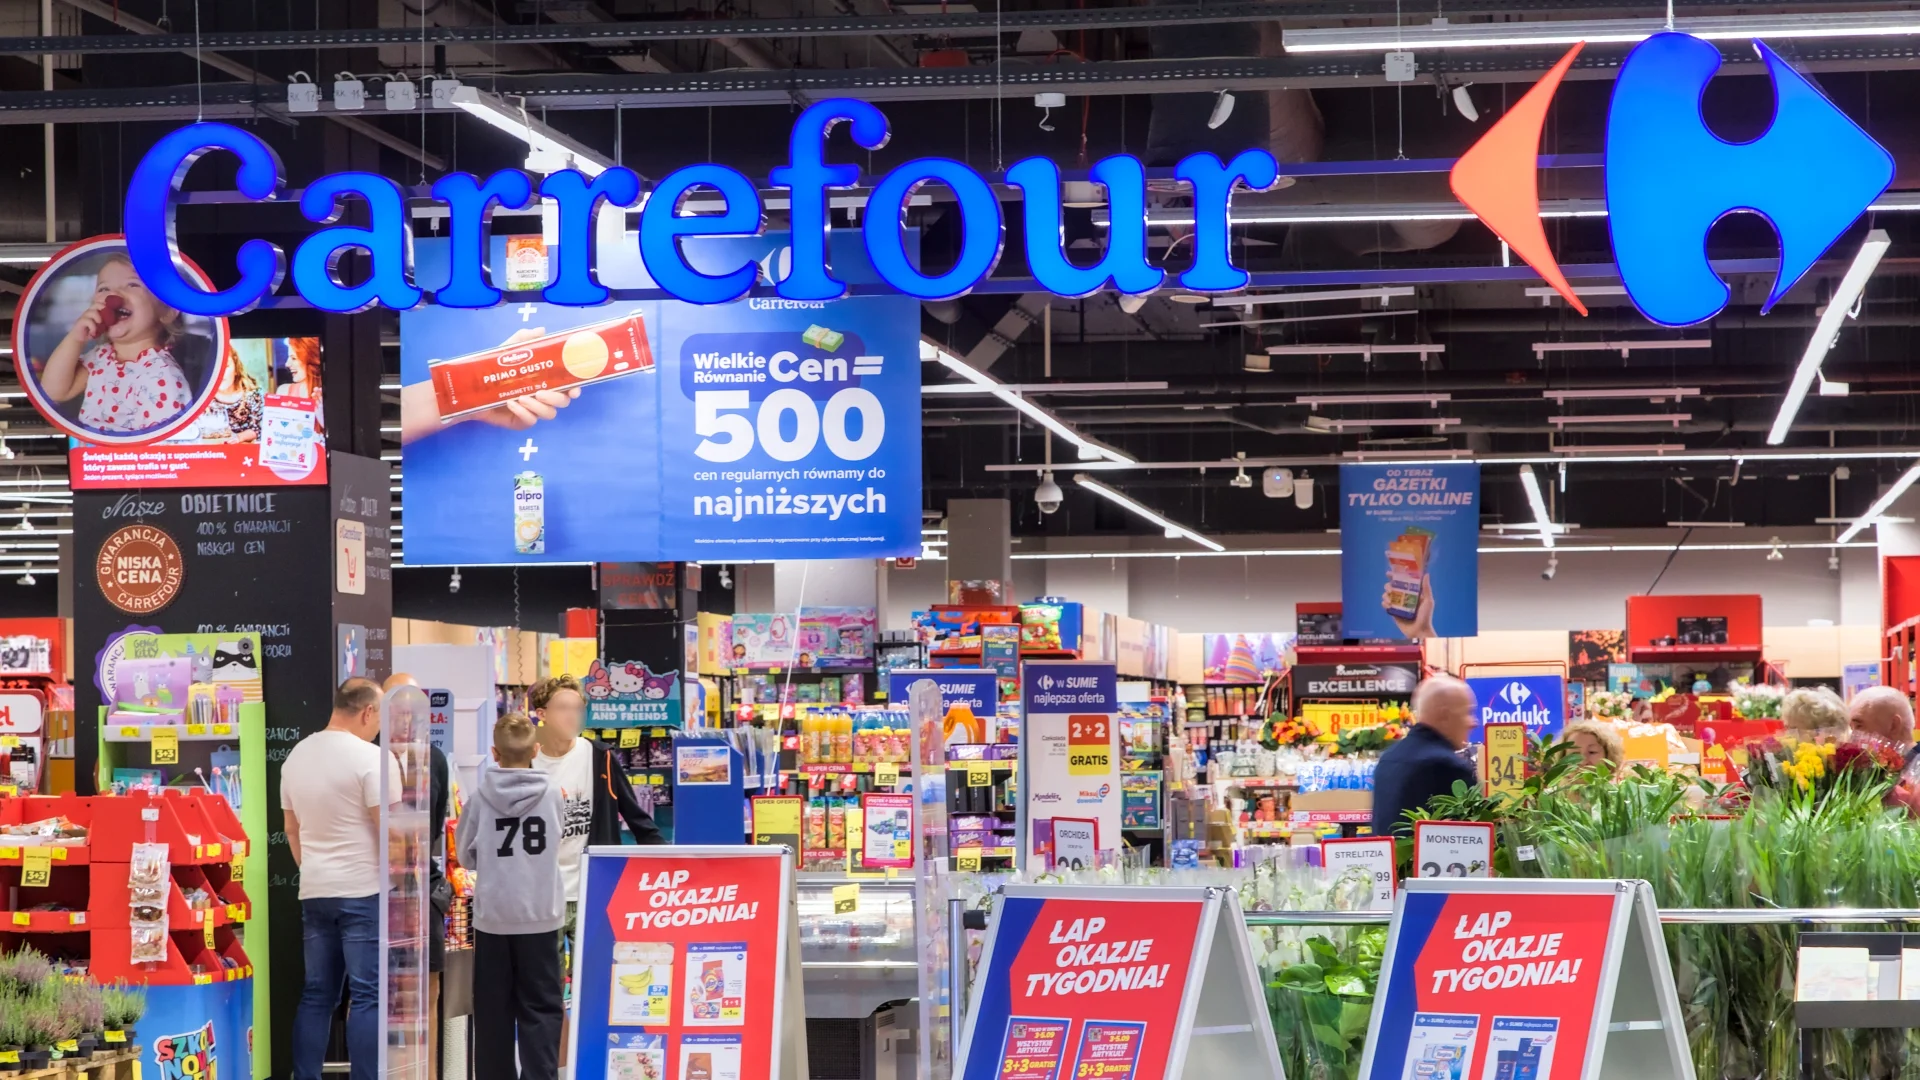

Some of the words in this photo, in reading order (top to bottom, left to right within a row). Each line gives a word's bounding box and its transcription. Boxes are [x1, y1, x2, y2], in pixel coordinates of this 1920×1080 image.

[125, 98, 1278, 317] Carrefour
[693, 351, 767, 370] Wielkie
[483, 369, 517, 384] PRIMO
[520, 360, 554, 375] GUSTO
[693, 370, 767, 384] Równanie
[694, 387, 886, 463] 500
[82, 451, 113, 462] Świętuj
[114, 451, 138, 462] każdą
[139, 451, 167, 461] okazję
[83, 462, 106, 472] który
[107, 464, 136, 472] zawsze
[160, 463, 169, 471] w
[1386, 469, 1401, 477] OD
[1404, 469, 1434, 477] TERAZ
[693, 470, 718, 481] cen
[720, 468, 800, 483] regularnych
[803, 467, 866, 482] równamy
[868, 467, 886, 479] do
[1373, 478, 1448, 491] GAZETKI
[515, 489, 542, 502] alpro
[1348, 493, 1403, 506] TYLKO
[1407, 492, 1473, 505] ONLINE
[101, 493, 167, 519] Nasze
[180, 492, 278, 514] OBIETNICE
[693, 486, 887, 522] najniższych
[100, 528, 167, 575] GWARANCJA
[117, 556, 163, 570] NISKA
[117, 569, 163, 584] CENA
[602, 569, 675, 587] SPRAWDŹ
[117, 566, 180, 609] CARREFOUR
[938, 683, 976, 695] SUMIE
[1066, 676, 1099, 689] SUMIE
[1308, 679, 1407, 693] EXCELLENCE
[1034, 692, 1077, 706] najlepsza
[1078, 692, 1105, 704] oferta
[591, 703, 628, 712] HELLO
[630, 702, 668, 712] KITTY
[1482, 704, 1551, 725] Produkt
[592, 712, 617, 721] AND
[620, 712, 669, 721] FRIENDS
[1495, 729, 1518, 740] FICUS
[1070, 755, 1108, 766] GRATIS
[1491, 755, 1516, 787] 34
[495, 815, 547, 857] 78
[1059, 829, 1091, 840] ORCHIDEA
[1425, 834, 1484, 845] MONSTERA
[1334, 850, 1384, 859] STRELITZIA
[638, 869, 690, 892] ŁAP
[649, 884, 739, 908] OKAZJE
[1381, 890, 1391, 900] zł
[624, 901, 759, 930] TYGODNIA!
[1048, 916, 1107, 944] ŁAP
[1453, 910, 1513, 940] ŁAP
[1055, 938, 1154, 968] OKAZJE
[1461, 932, 1564, 963] OKAZJE
[1024, 963, 1171, 998] TYGODNIA!
[1431, 957, 1584, 994] TYGODNIA!
[1091, 1043, 1129, 1052] WSZYSTKIE
[1002, 1058, 1031, 1073] 3+3
[1029, 1059, 1057, 1069] GRATIS!
[1077, 1062, 1106, 1077] 3+3
[1104, 1063, 1132, 1073] GRATIS!
